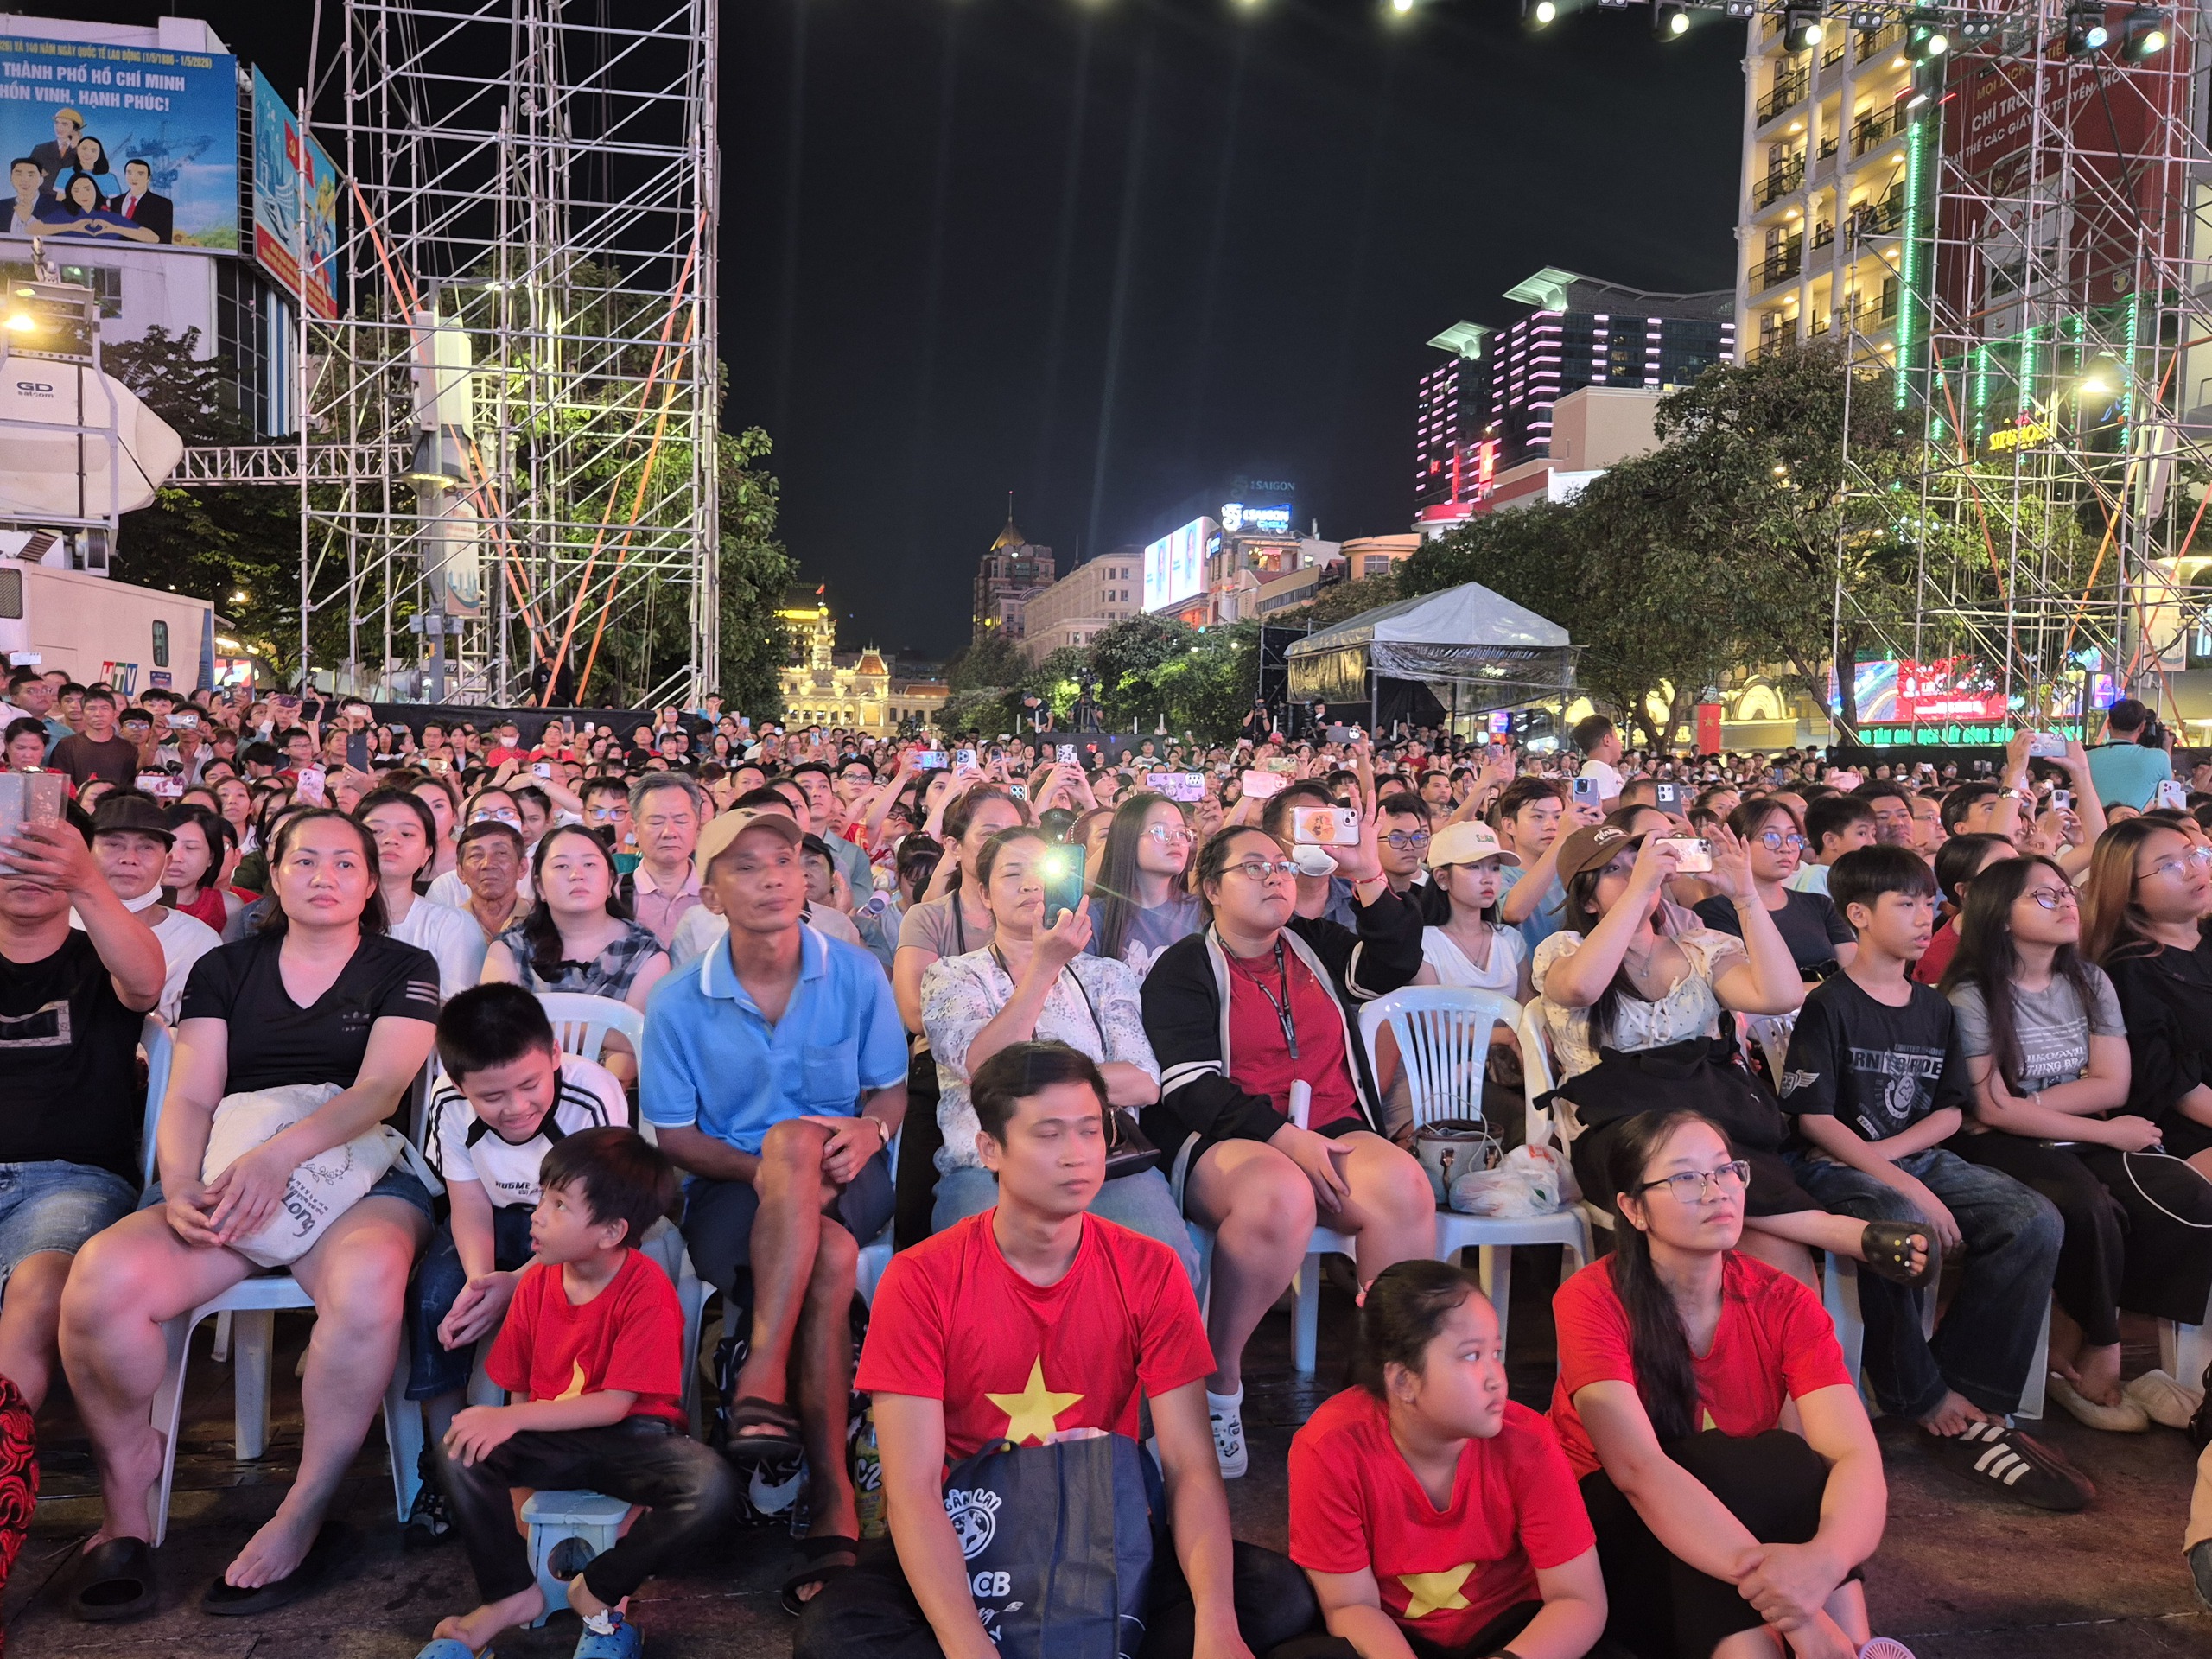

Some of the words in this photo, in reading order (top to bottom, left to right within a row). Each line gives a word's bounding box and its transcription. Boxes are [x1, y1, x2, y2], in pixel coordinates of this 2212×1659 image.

[107, 48, 121, 60] LAO
[3, 60, 53, 80] THÀNH
[56, 62, 87, 84] PHỐ
[116, 70, 141, 88] CHÍ
[145, 73, 185, 92] MINH
[35, 86, 75, 105] VINH,
[79, 90, 120, 109] HẠNH
[124, 92, 170, 112] PHÚC!
[1972, 101, 1997, 133] CHỈ
[2057, 68, 2064, 86] 1
[1976, 85, 1997, 100] MỌI
[1966, 136, 1983, 158] THẾ
[1984, 128, 2005, 148] CÁC
[2051, 83, 2094, 111] TRYỀN
[16, 381, 54, 392] GD
[1851, 1050, 1881, 1071] RN
[857, 1458, 882, 1491] C2
[966, 1571, 1011, 1598] CB
